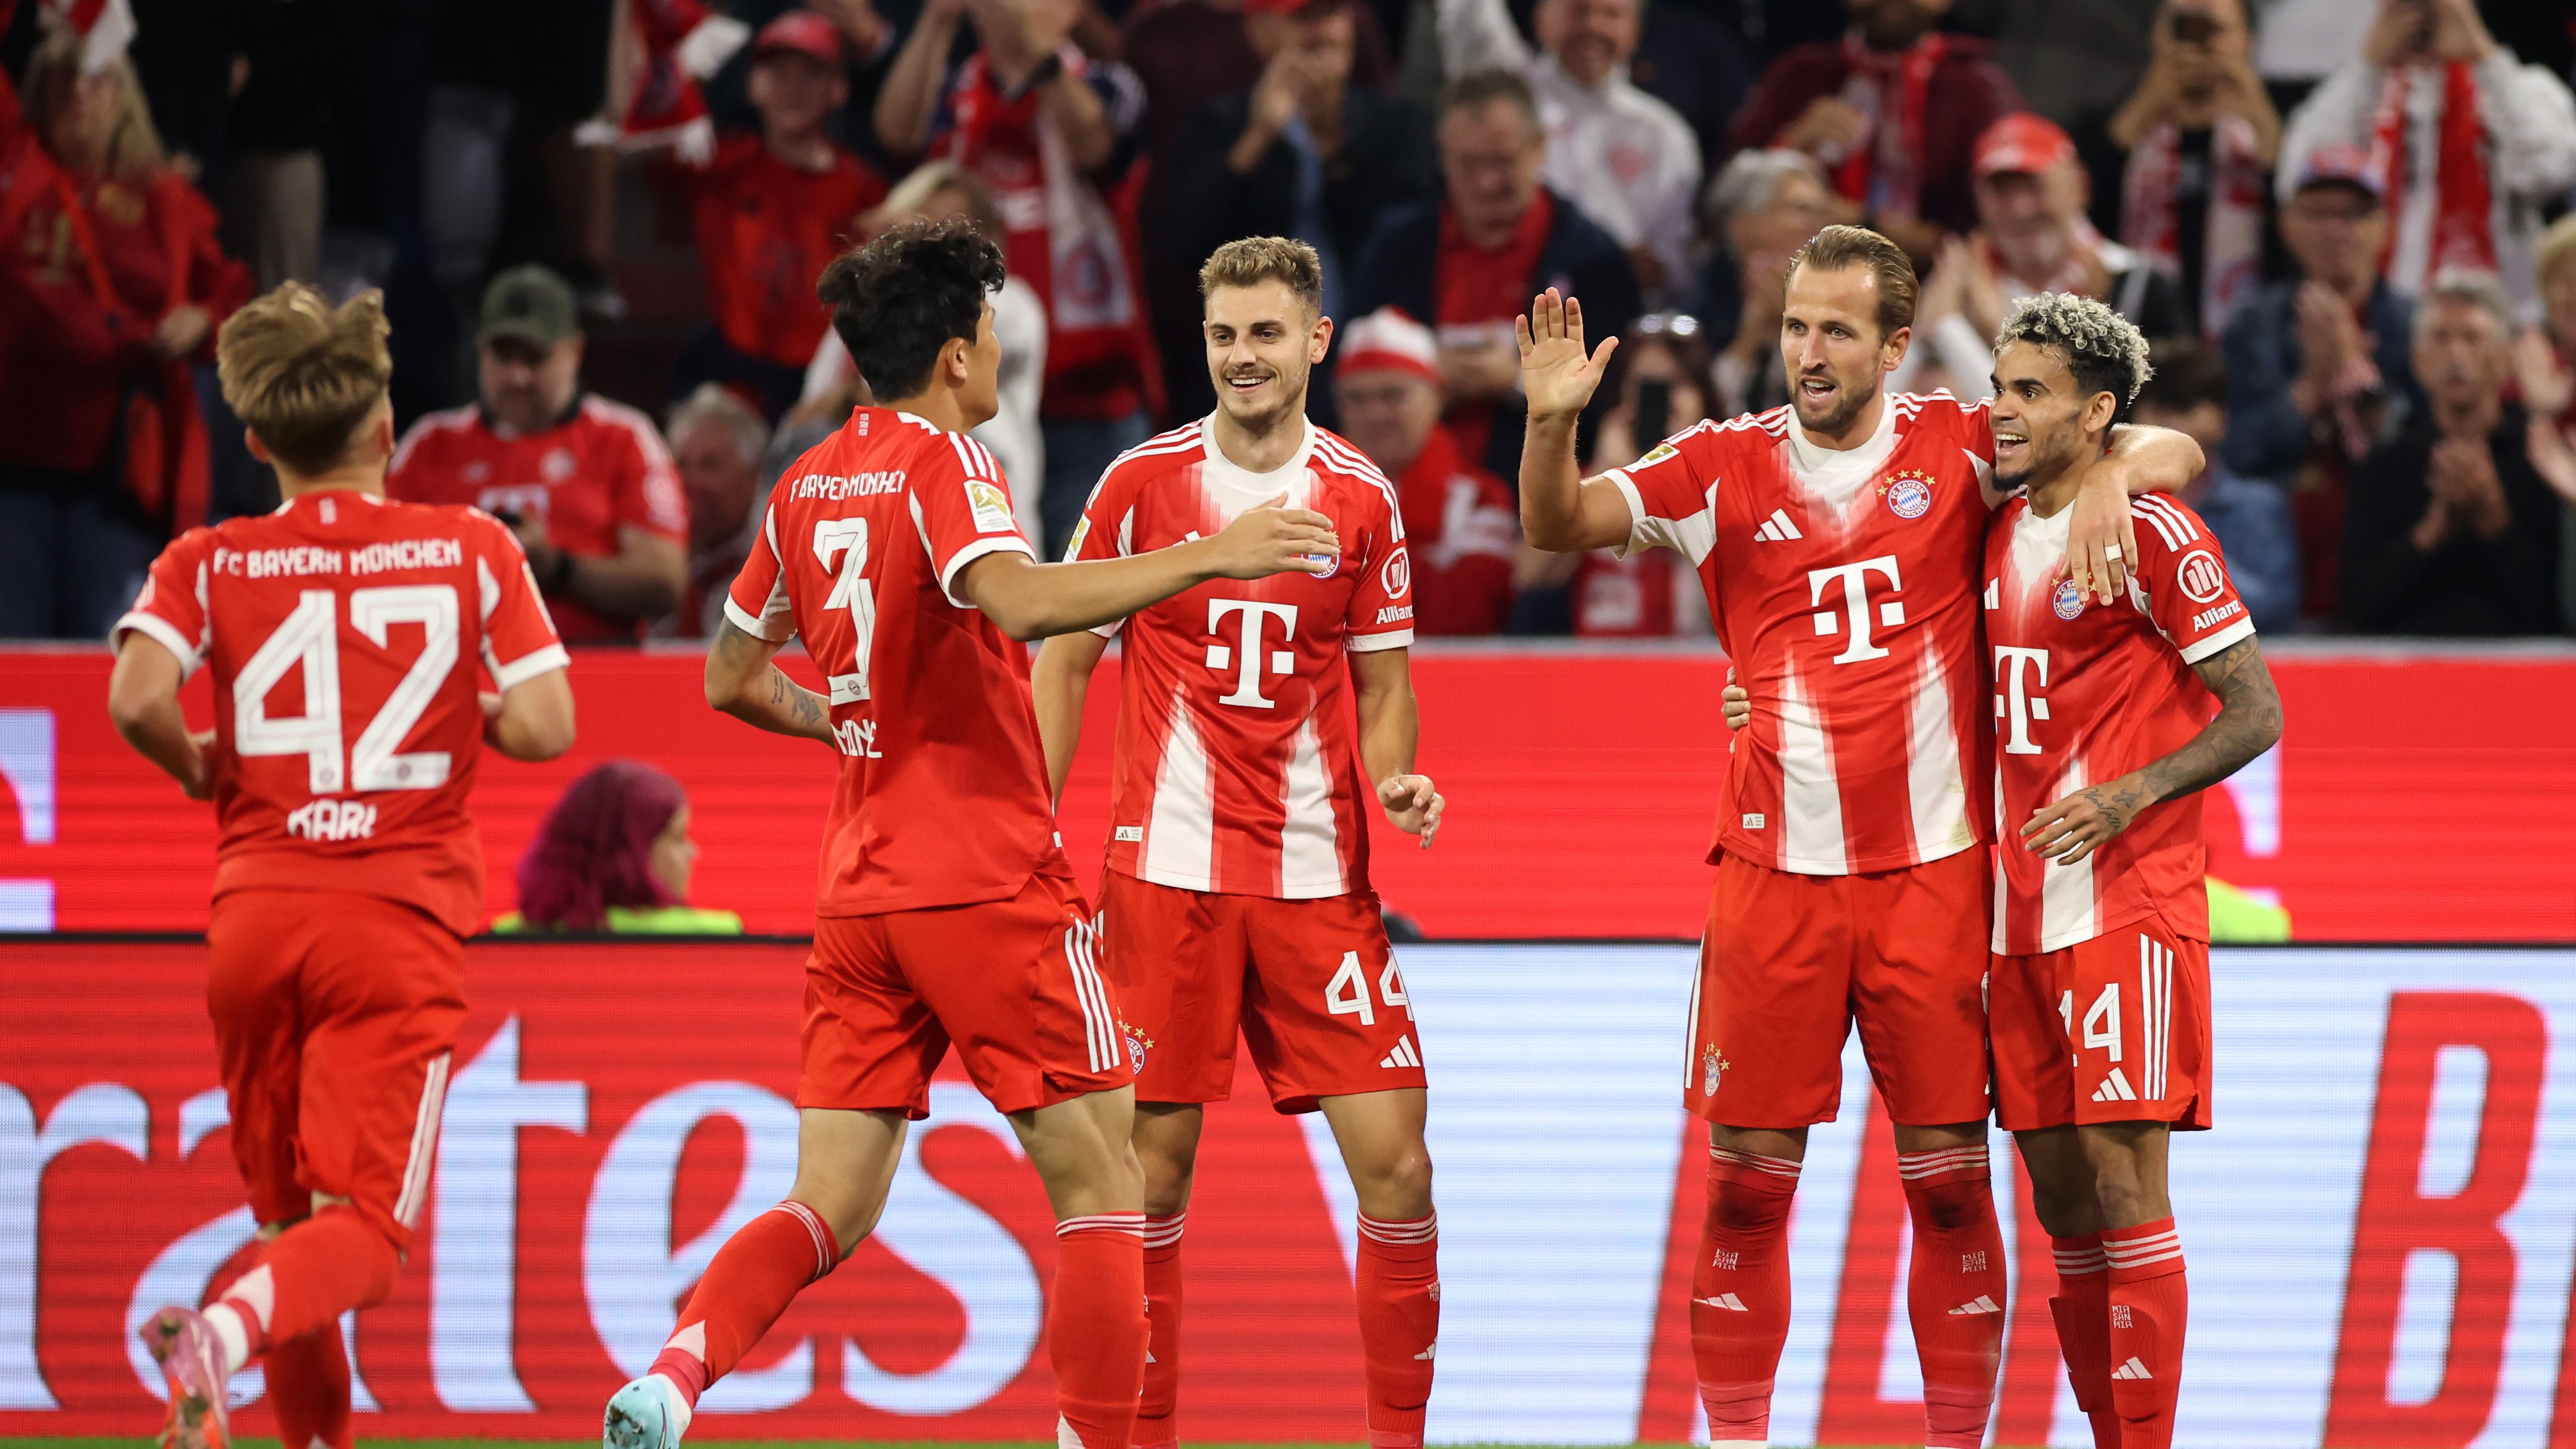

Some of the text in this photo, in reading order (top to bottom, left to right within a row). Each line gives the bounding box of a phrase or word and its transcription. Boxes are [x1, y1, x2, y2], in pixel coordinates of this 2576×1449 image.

[790, 478, 800, 503] F
[1897, 482, 1926, 494] BAYERN
[213, 547, 244, 577] FC
[247, 546, 343, 578] BAYERN
[2192, 599, 2241, 633] Allianz
[233, 584, 460, 795] 42
[1325, 950, 1414, 1026] 44
[2320, 990, 2576, 1449] B
[2112, 1305, 2130, 1313] MIA
[2113, 1313, 2131, 1321] SAN
[2113, 1320, 2133, 1329] MIA
